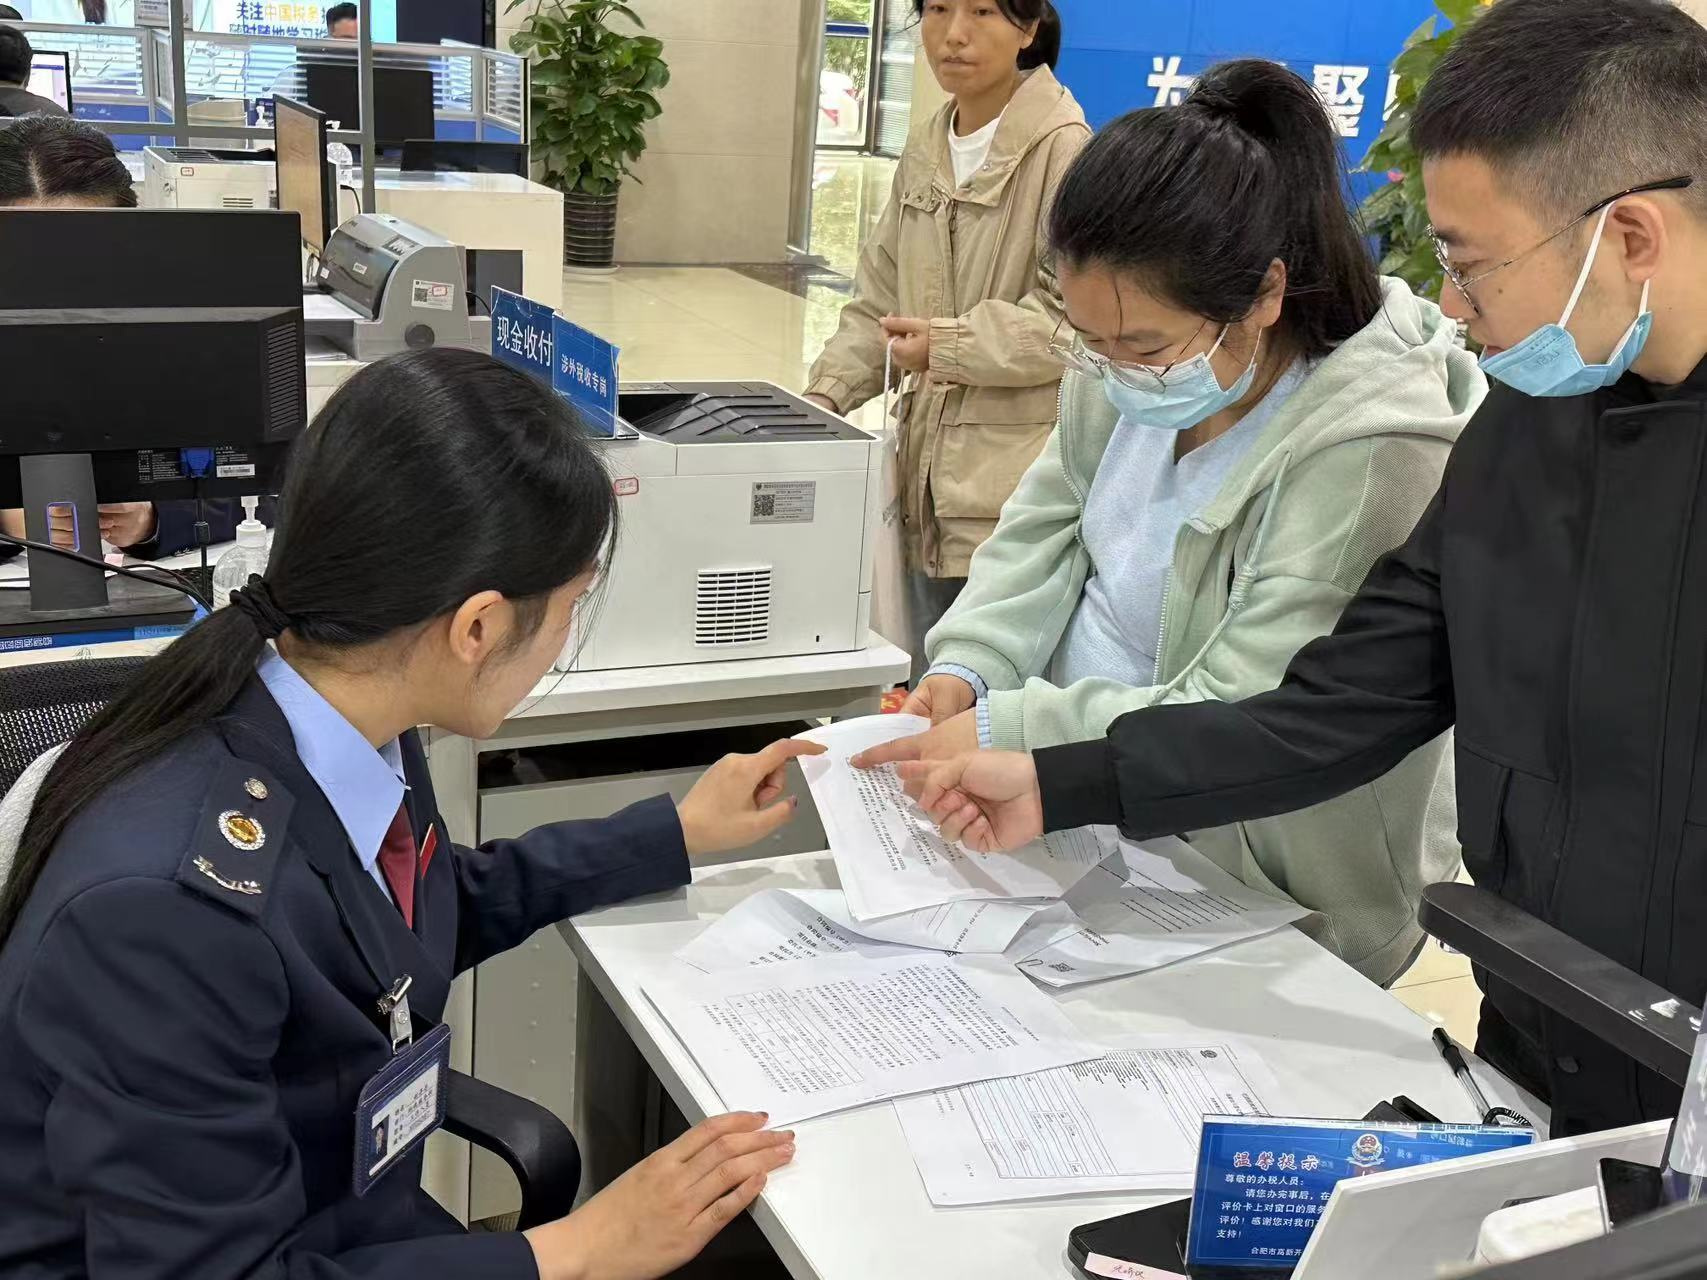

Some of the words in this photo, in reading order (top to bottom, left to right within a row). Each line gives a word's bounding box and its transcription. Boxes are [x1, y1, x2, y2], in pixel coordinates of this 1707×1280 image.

[496, 315, 553, 367] 现金收付
[561, 353, 607, 398] 涉外税收专岗
[1232, 1151, 1320, 1171] 温馨提示
[1225, 1174, 1304, 1186] 尊敬的办税人员：
[1216, 1229, 1242, 1239] 支持！
